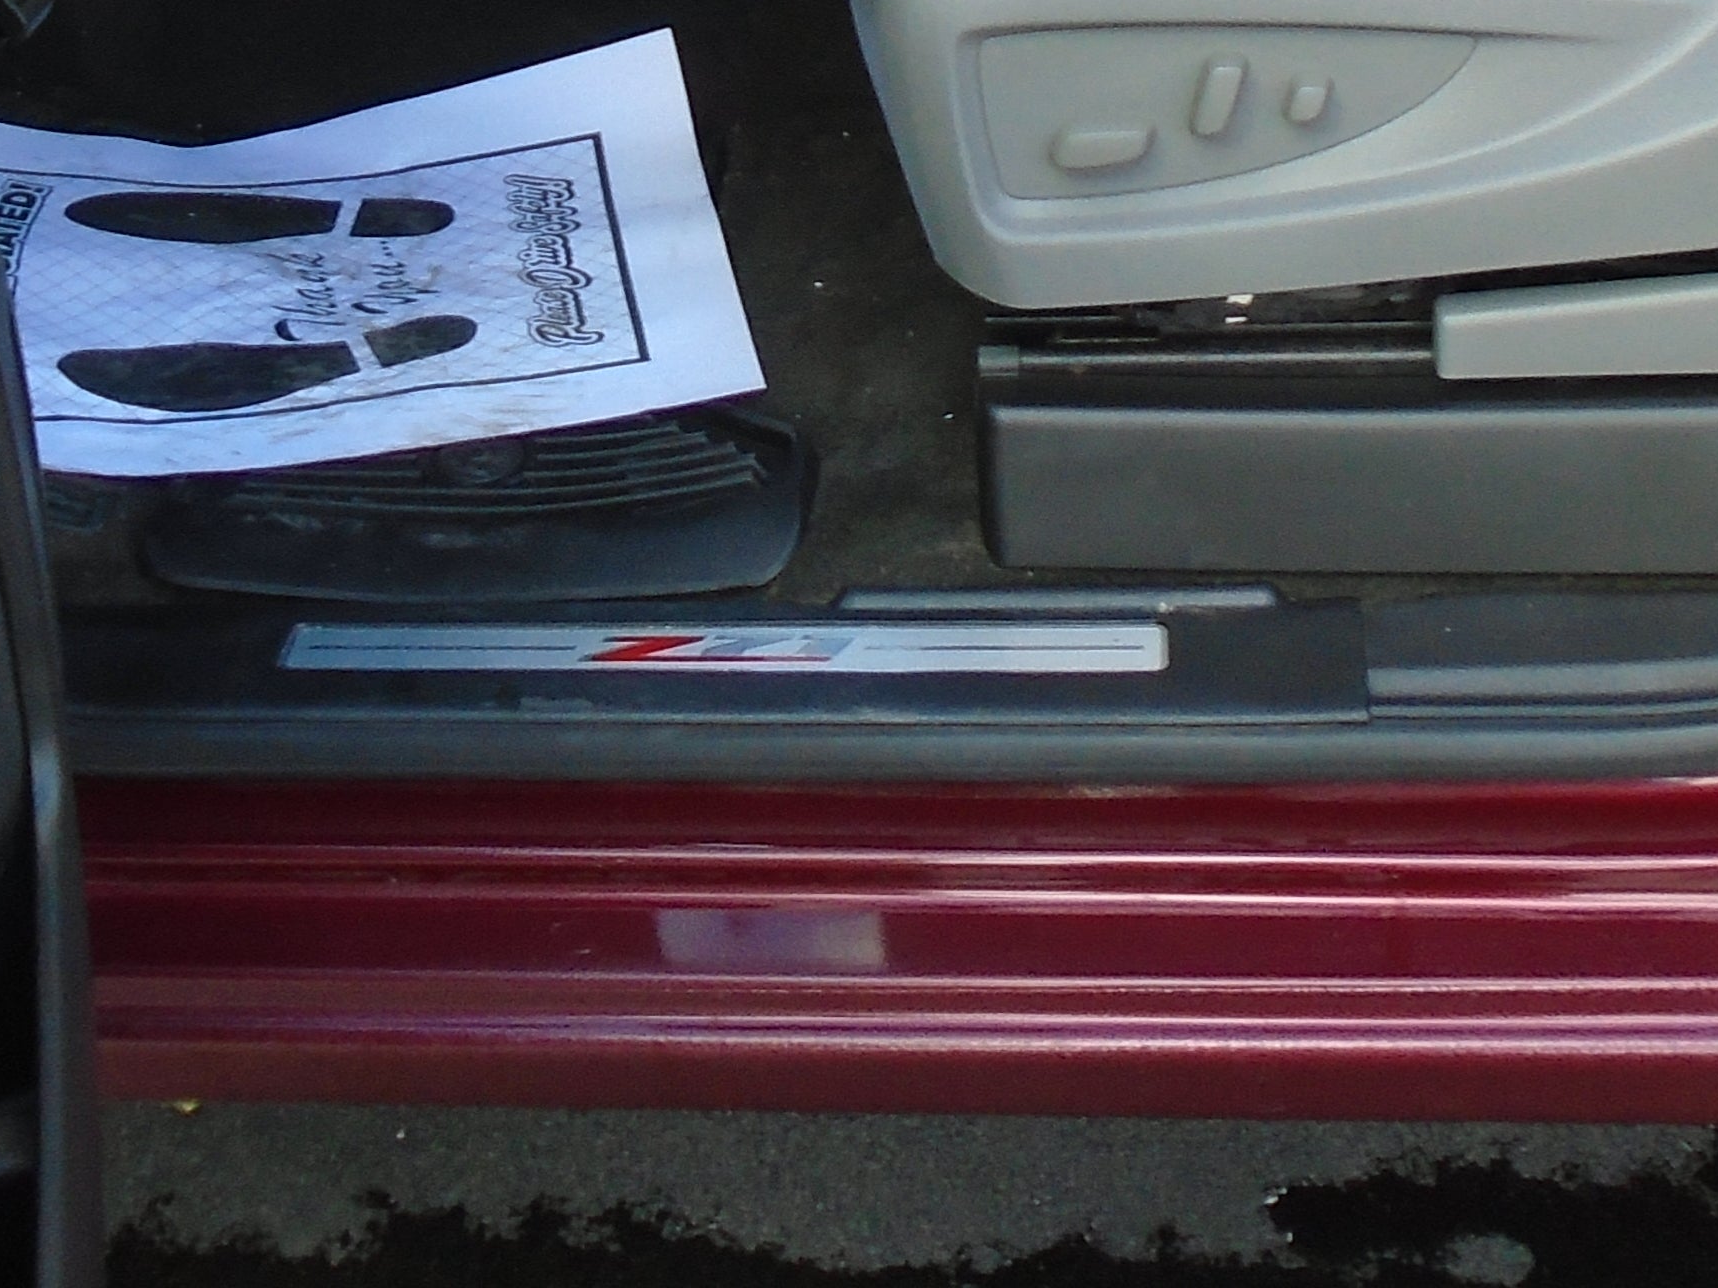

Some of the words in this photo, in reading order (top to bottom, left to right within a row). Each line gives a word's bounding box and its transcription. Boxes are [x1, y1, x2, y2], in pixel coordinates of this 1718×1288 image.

[503, 173, 582, 234] Safely!
[517, 233, 594, 289] Drive
[267, 252, 347, 342] Thank
[527, 287, 606, 348] Please
[577, 635, 856, 663] Z71
